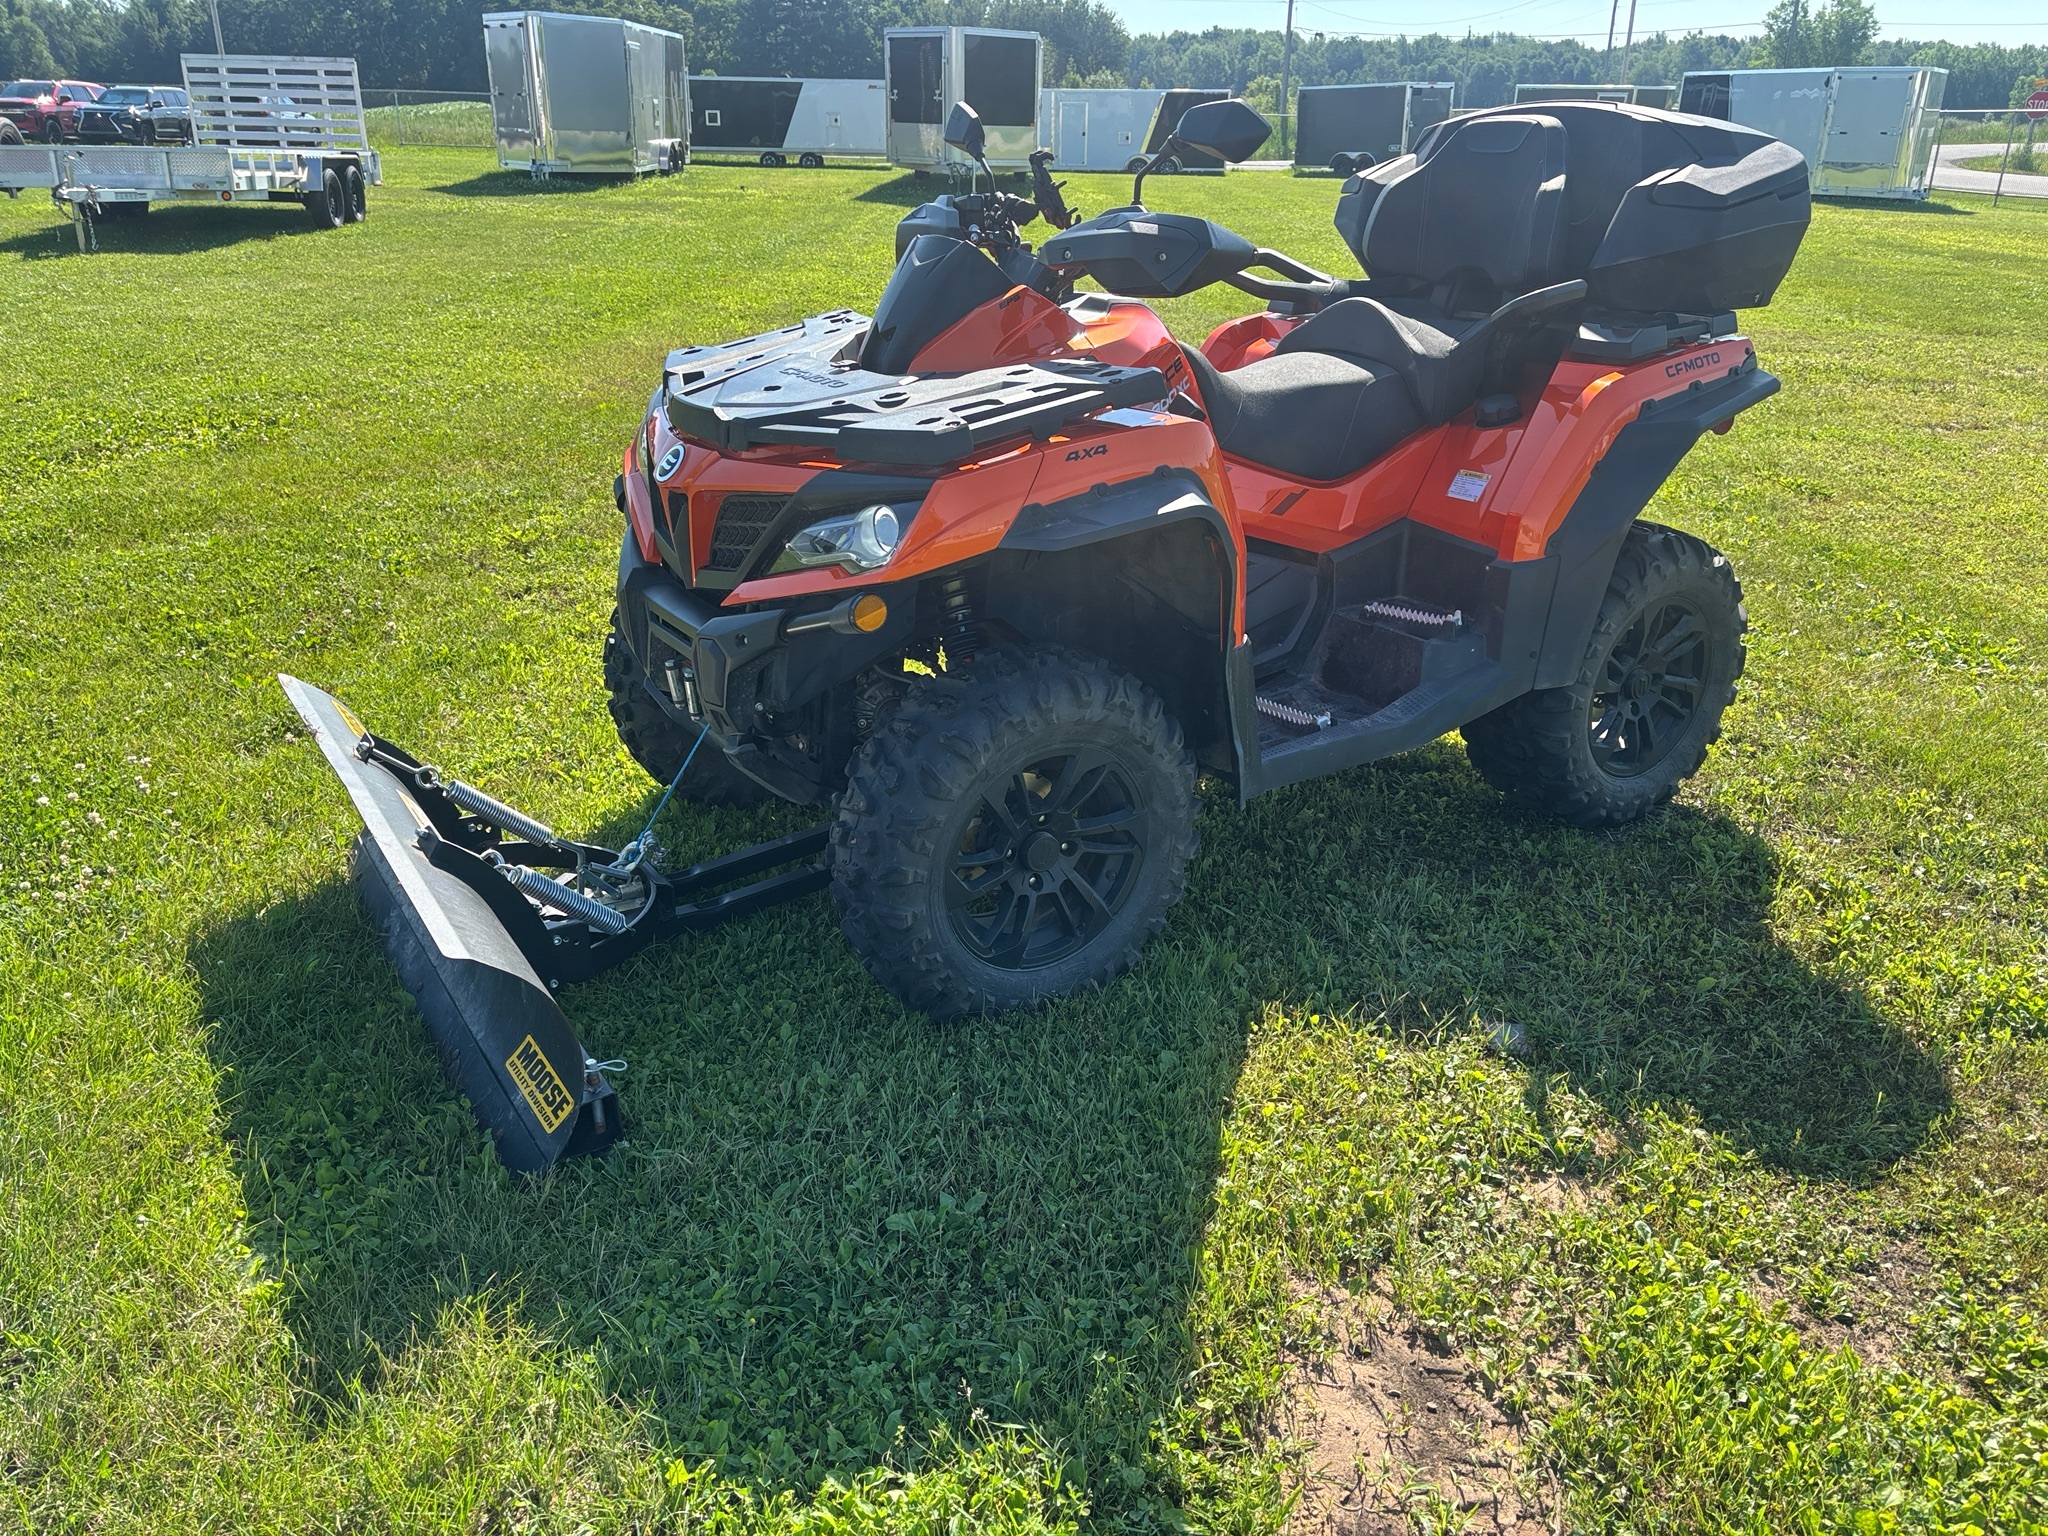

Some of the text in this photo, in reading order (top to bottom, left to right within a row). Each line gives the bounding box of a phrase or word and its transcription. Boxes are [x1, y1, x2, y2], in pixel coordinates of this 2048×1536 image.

[999, 293, 1021, 309] EPS
[1665, 352, 1720, 378] CFMOTO
[508, 1059, 555, 1129] UTILITY DIVISION
[516, 1040, 571, 1121] MOOSE
